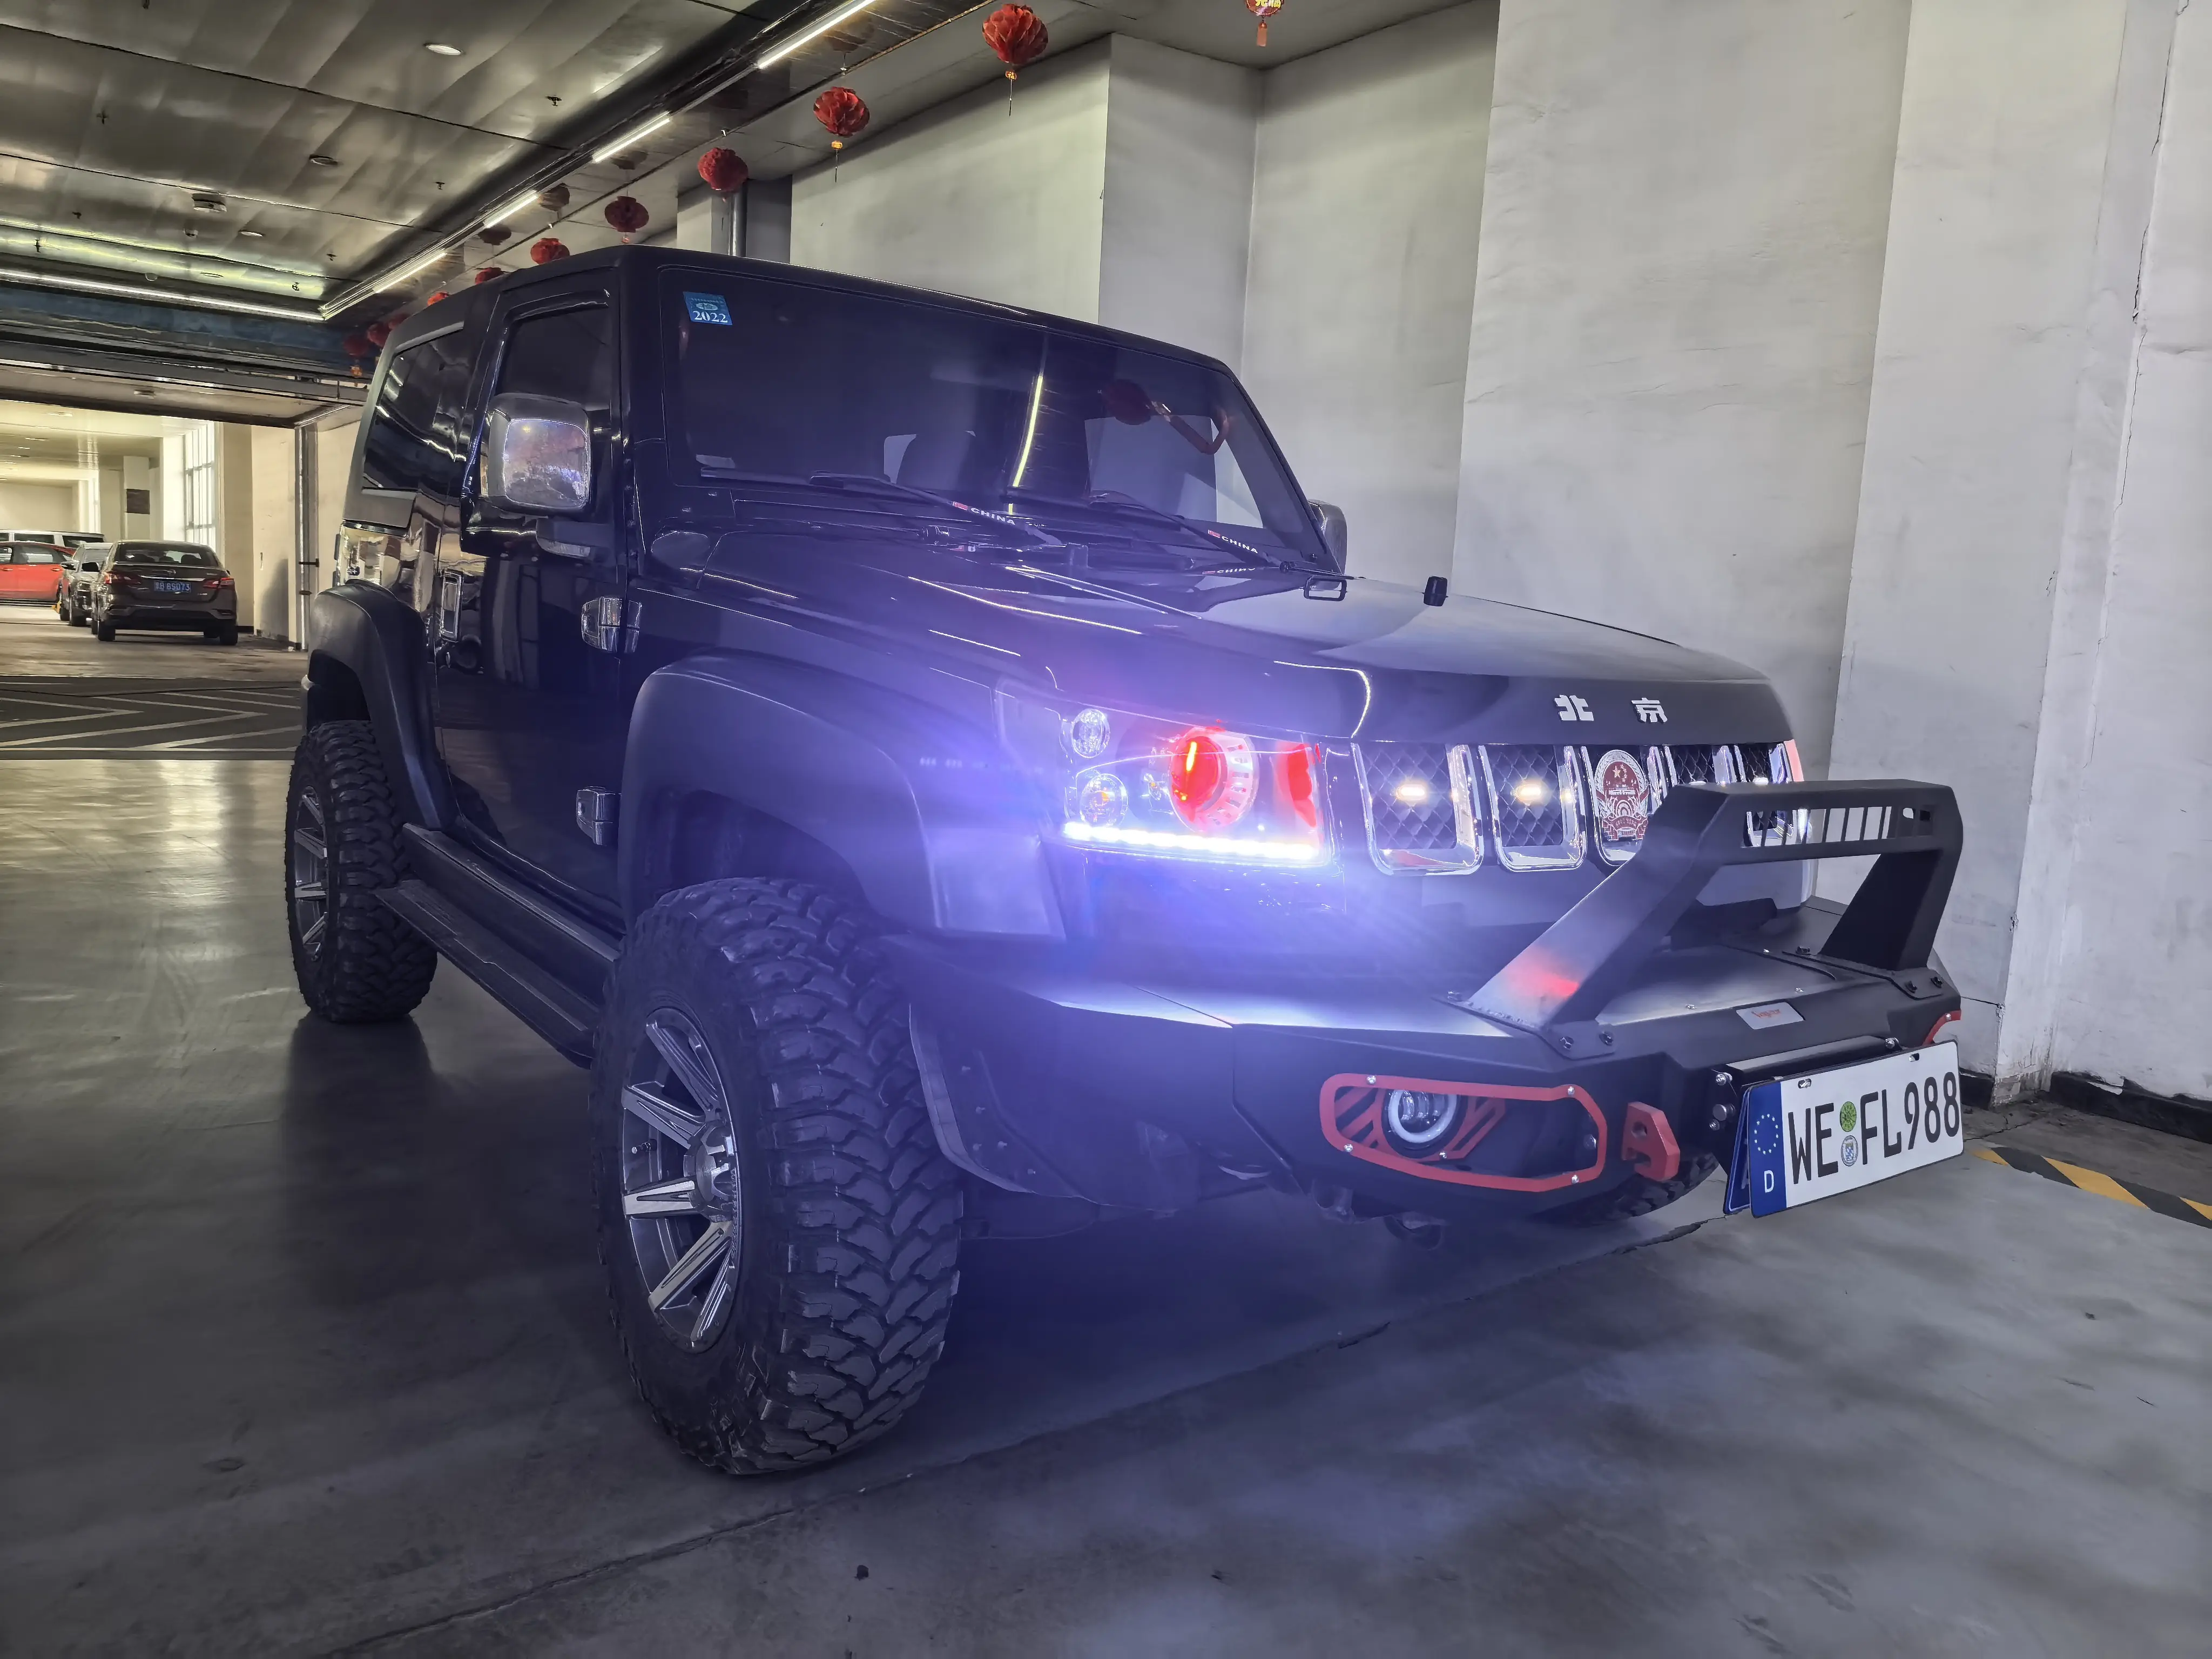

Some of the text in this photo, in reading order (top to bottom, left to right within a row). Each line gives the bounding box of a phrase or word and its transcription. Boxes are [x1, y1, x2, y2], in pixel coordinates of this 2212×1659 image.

[693, 311, 728, 323] 2022
[970, 508, 1016, 525] CHINA
[1222, 536, 1258, 554] CHINA
[1554, 694, 1668, 723] 北京
[1764, 1170, 1775, 1193] D
